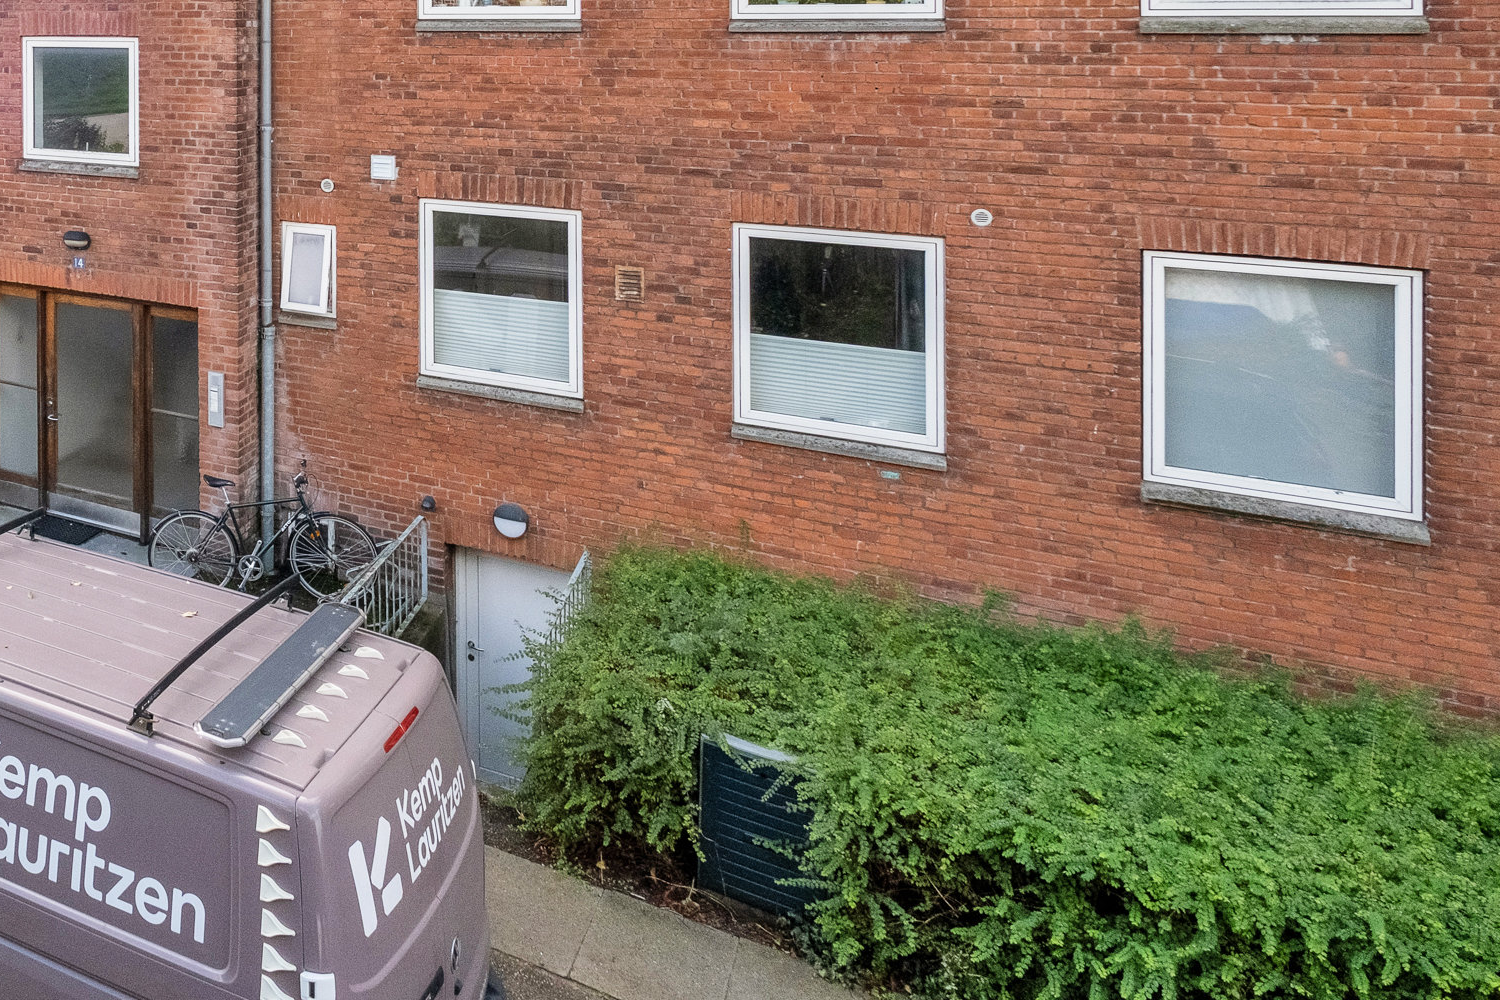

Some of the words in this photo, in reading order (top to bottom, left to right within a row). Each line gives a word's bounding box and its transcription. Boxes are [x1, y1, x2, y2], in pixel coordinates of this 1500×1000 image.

[74, 257, 84, 268] 14
[395, 756, 443, 839] Kemp
[405, 764, 466, 884] Lauritzen
